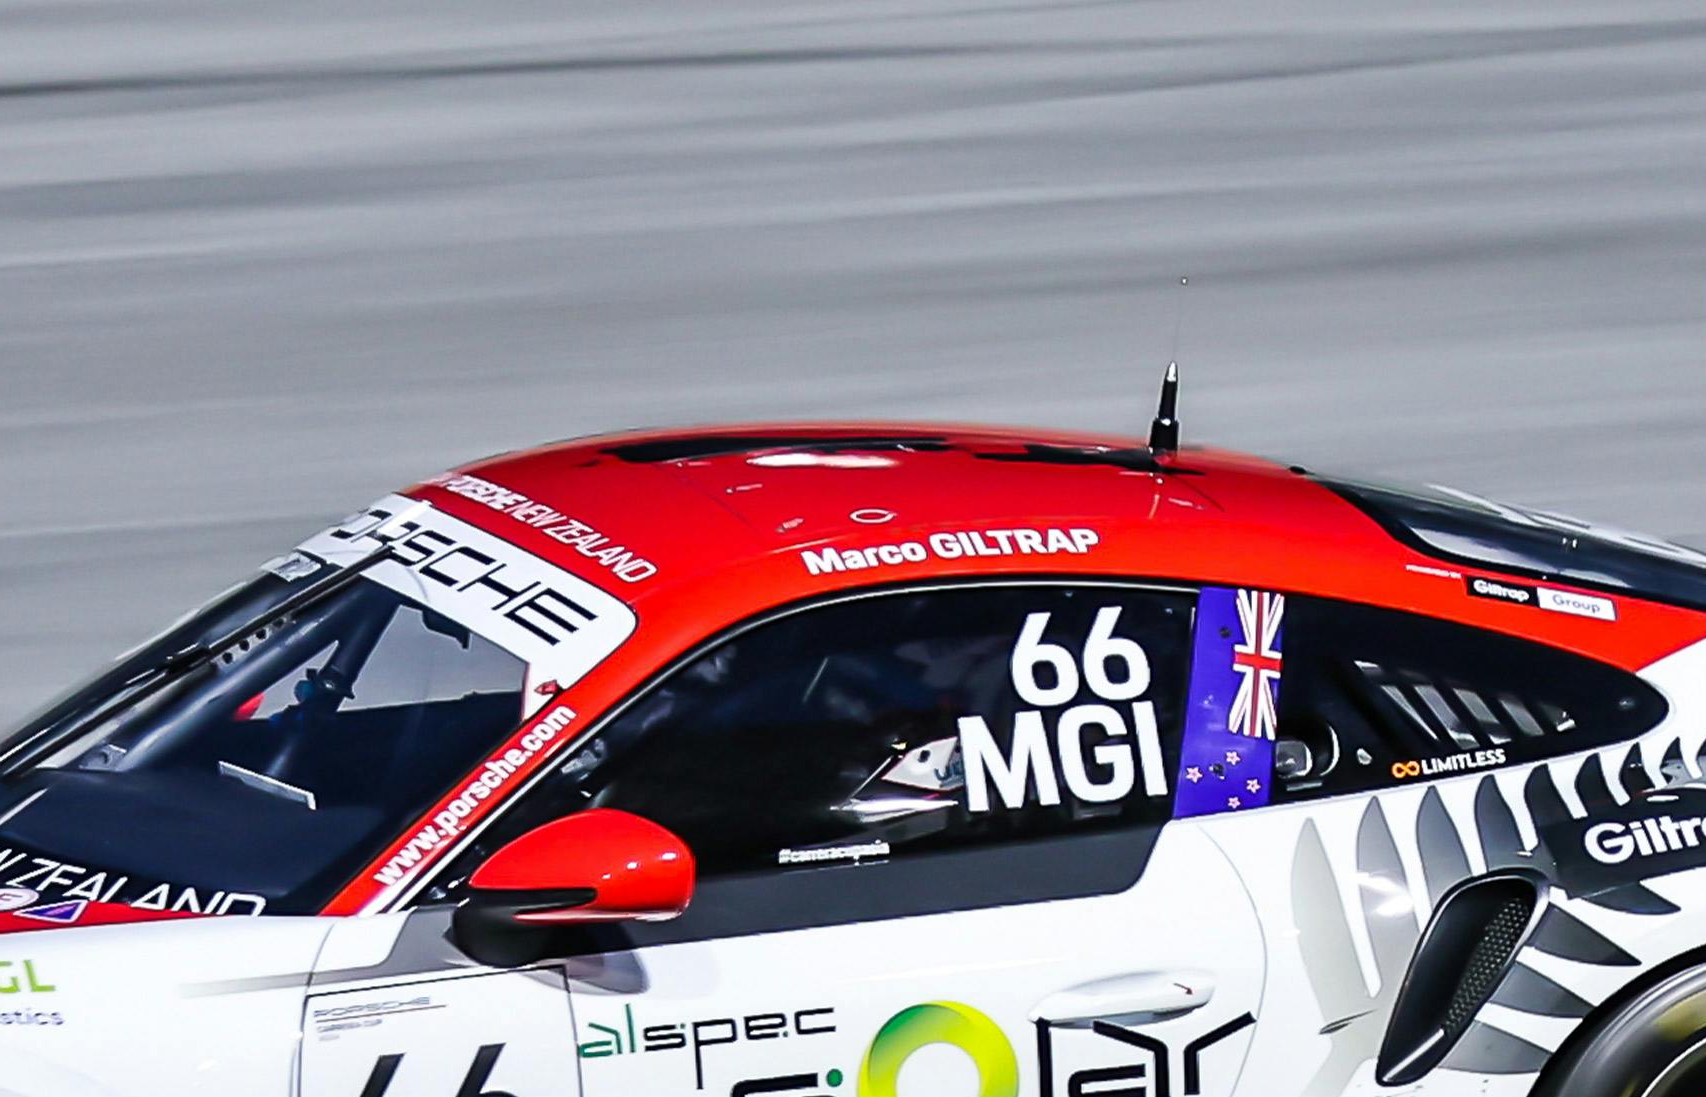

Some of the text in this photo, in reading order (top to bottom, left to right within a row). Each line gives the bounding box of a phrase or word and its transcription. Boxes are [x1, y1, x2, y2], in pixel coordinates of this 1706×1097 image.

[503, 499, 567, 527] NEW
[542, 518, 658, 583] ZEALAND
[800, 528, 1099, 576] Marco GILTRAP
[1473, 579, 1601, 613] Giltrap Group
[1011, 605, 1151, 707] 66
[373, 705, 577, 886] www.porsche.com
[957, 700, 1168, 812] MGI
[1421, 748, 1507, 775] LIMITLESS
[577, 1003, 836, 1090] alspec
